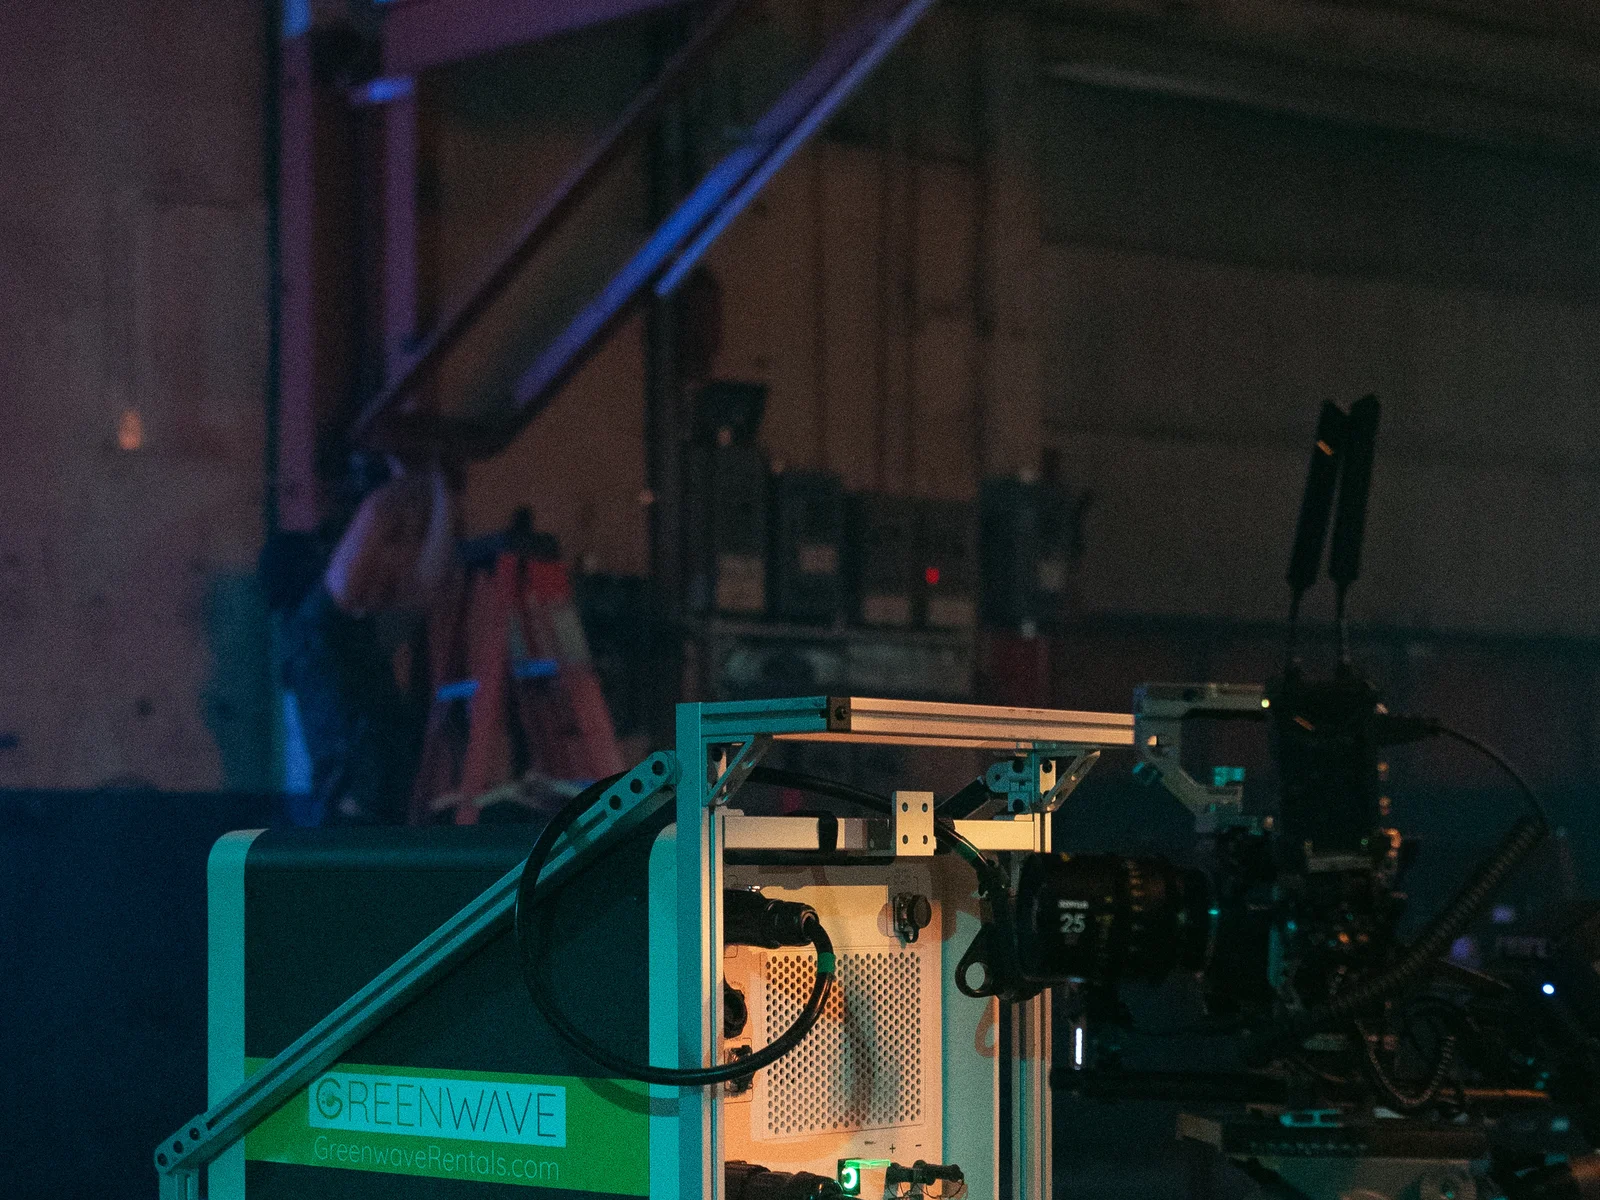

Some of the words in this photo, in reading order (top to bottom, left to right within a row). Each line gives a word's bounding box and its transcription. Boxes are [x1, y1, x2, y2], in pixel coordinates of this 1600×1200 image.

[1060, 913, 1086, 933] 25
[316, 1078, 557, 1137] GREENWAVE
[313, 1135, 560, 1181] GreenwaveRentals.com
